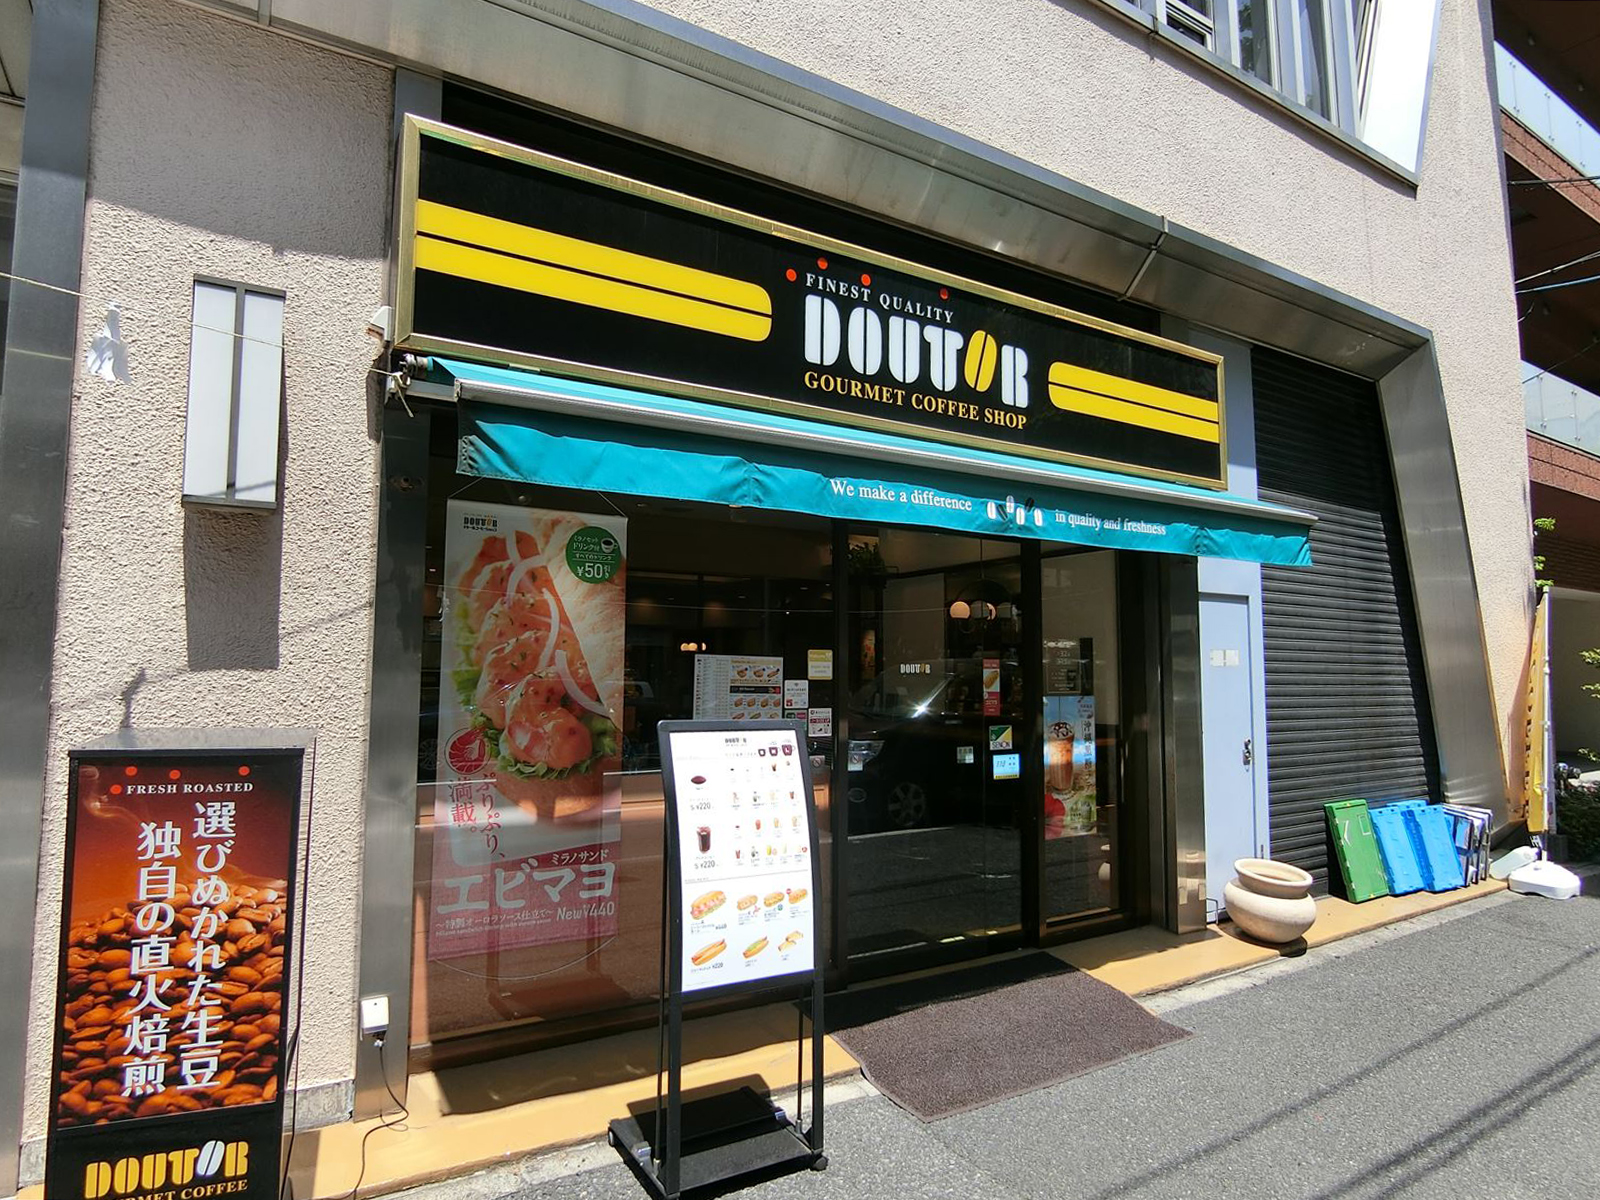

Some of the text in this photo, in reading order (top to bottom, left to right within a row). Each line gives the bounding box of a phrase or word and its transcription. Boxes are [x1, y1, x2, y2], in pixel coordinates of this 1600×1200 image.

[806, 272, 954, 323] FINEST QUALITY
[804, 294, 1029, 409] DOUTOR
[804, 371, 1027, 430] GOURMET COFFEE SHOP
[829, 478, 1166, 536] We make a difference in quality and freshness
[127, 782, 254, 795] FRESH ROASTED
[437, 858, 616, 914] エビマヨ
[552, 849, 609, 866] ミラノサンド
[120, 820, 181, 1098] 独自の直火焙煎
[176, 801, 237, 1091] 選びぬかれた生豆
[84, 1140, 249, 1199] DOUTOR
[181, 1179, 248, 1200] COFFEE
